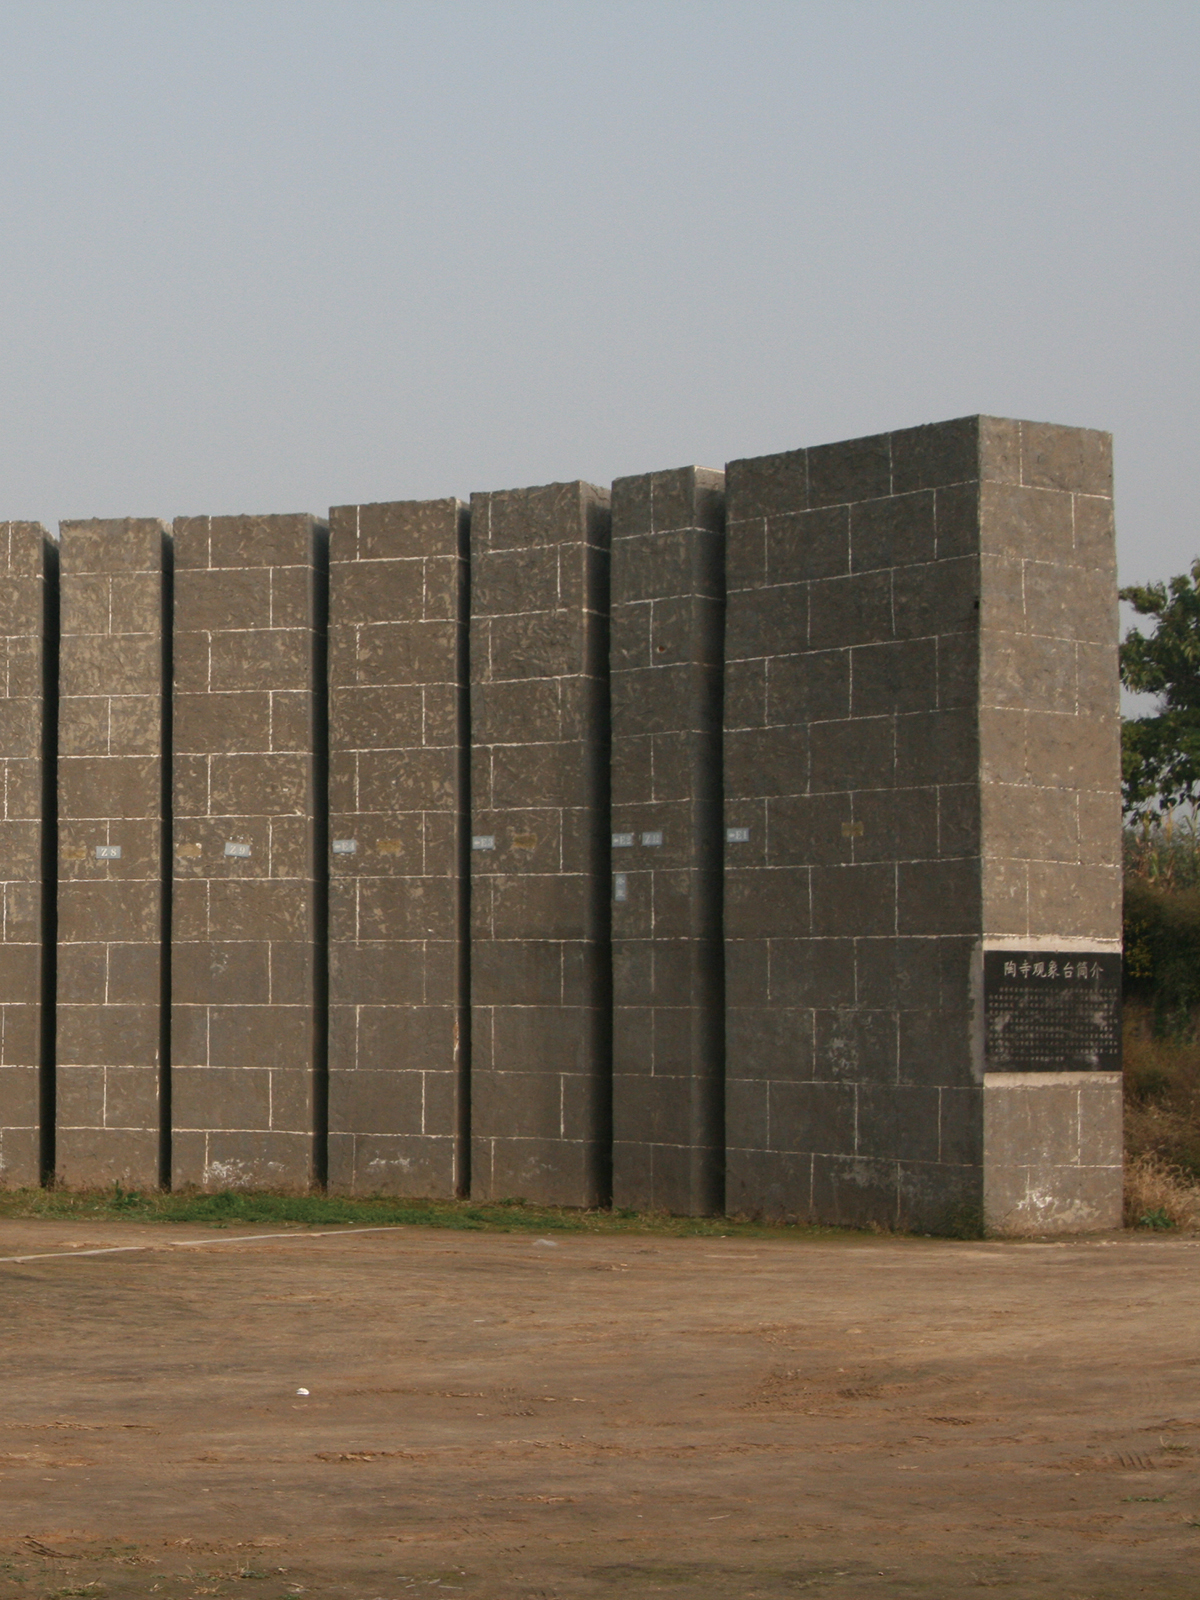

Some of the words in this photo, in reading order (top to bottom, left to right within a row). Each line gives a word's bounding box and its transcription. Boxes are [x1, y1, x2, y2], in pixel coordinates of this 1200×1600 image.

[619, 835, 631, 844] E2
[735, 830, 748, 840] E1
[1003, 959, 1104, 979] 陶寺观象台简介
